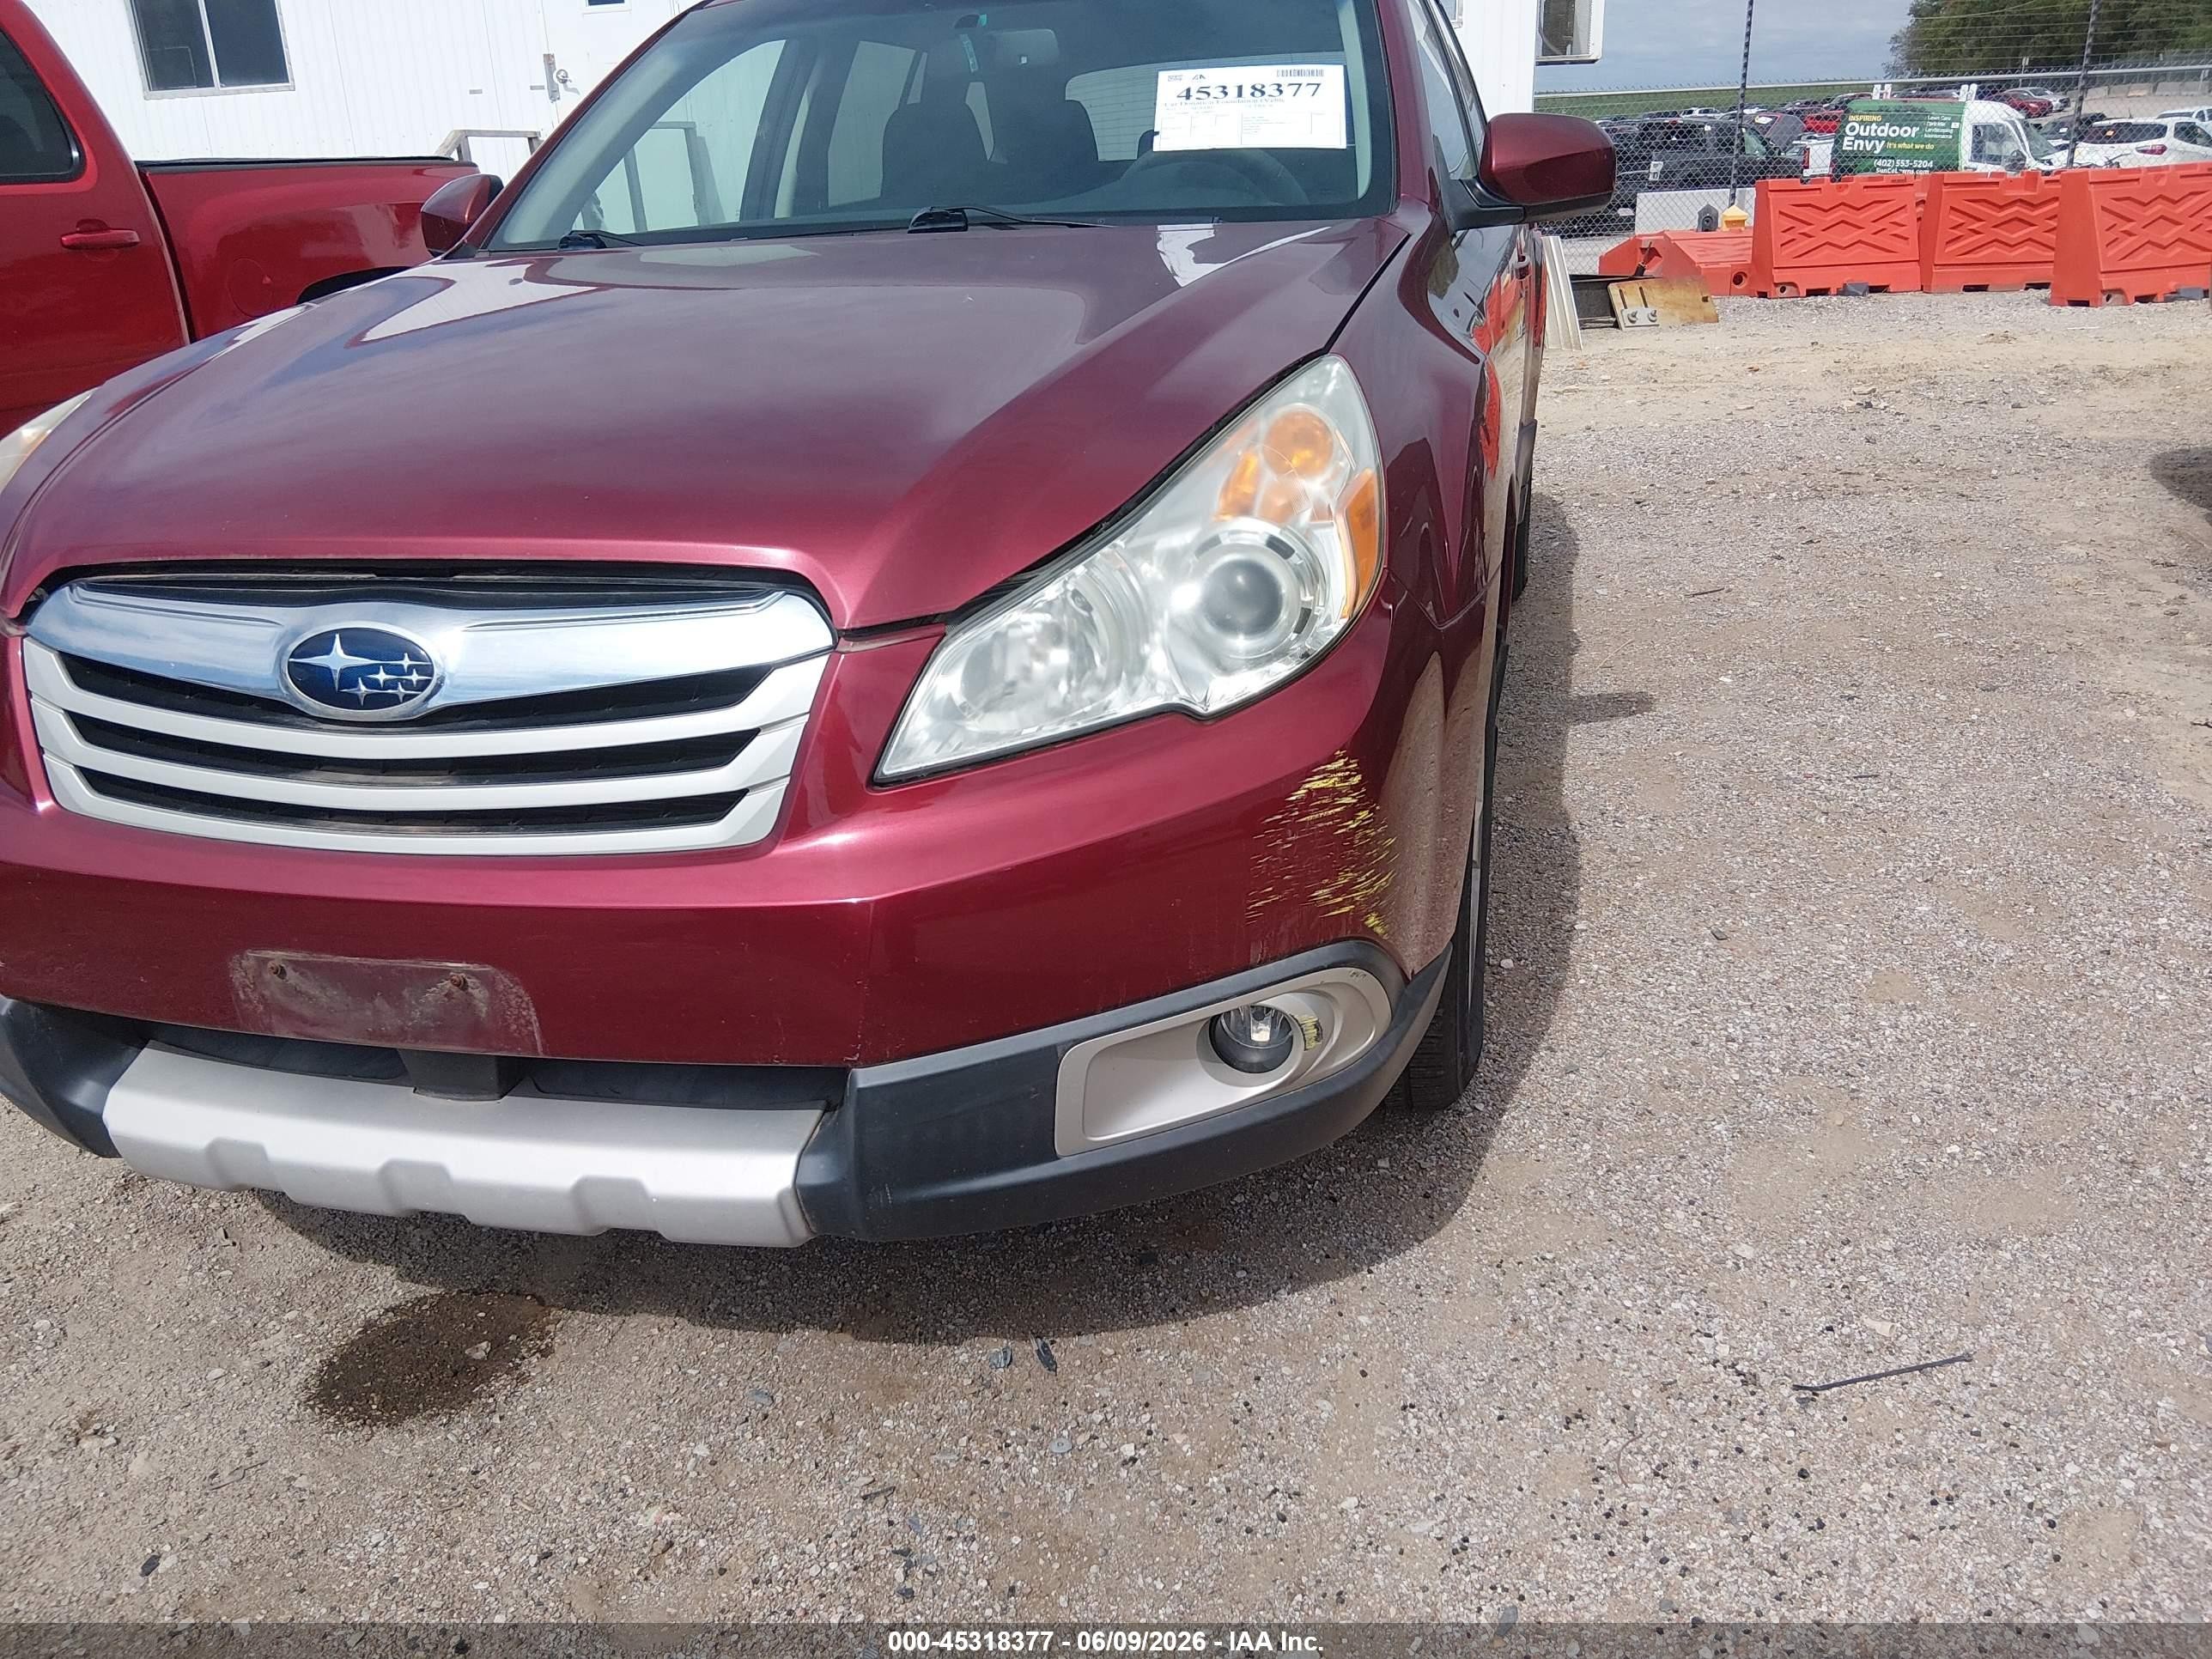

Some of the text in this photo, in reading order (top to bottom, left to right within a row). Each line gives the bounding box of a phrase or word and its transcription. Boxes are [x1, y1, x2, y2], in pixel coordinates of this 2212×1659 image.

[1176, 82, 1322, 100] 45318377
[1844, 121, 1920, 138] Outdoor
[1842, 137, 1886, 155] Envy
[1874, 159, 1894, 167] (402)
